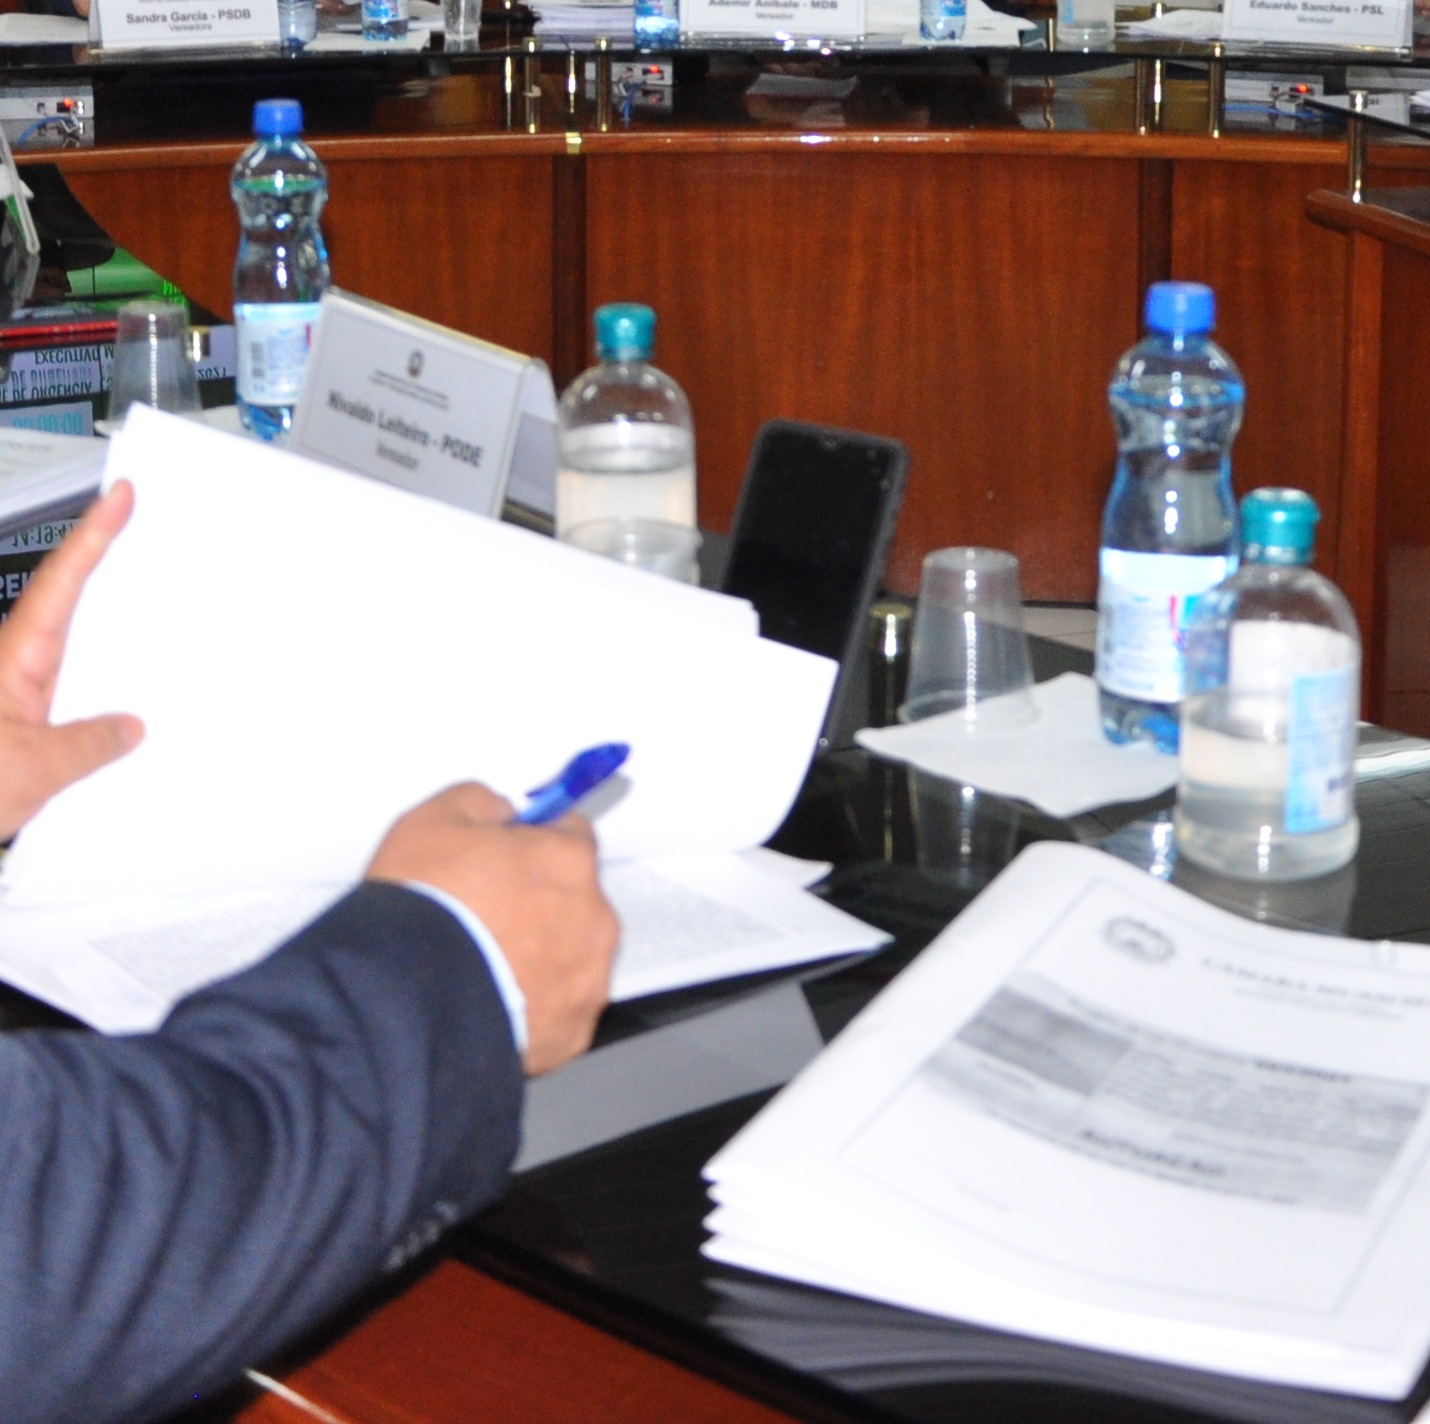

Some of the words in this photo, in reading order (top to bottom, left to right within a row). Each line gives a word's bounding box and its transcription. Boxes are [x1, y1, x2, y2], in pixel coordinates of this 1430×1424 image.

[810, 0, 838, 10] MDB
[1301, 1, 1351, 14] Sanches
[1361, 4, 1385, 15] PSL
[126, 11, 167, 24] Sandra
[171, 9, 208, 22] Garcia
[218, 8, 251, 20] PSDB
